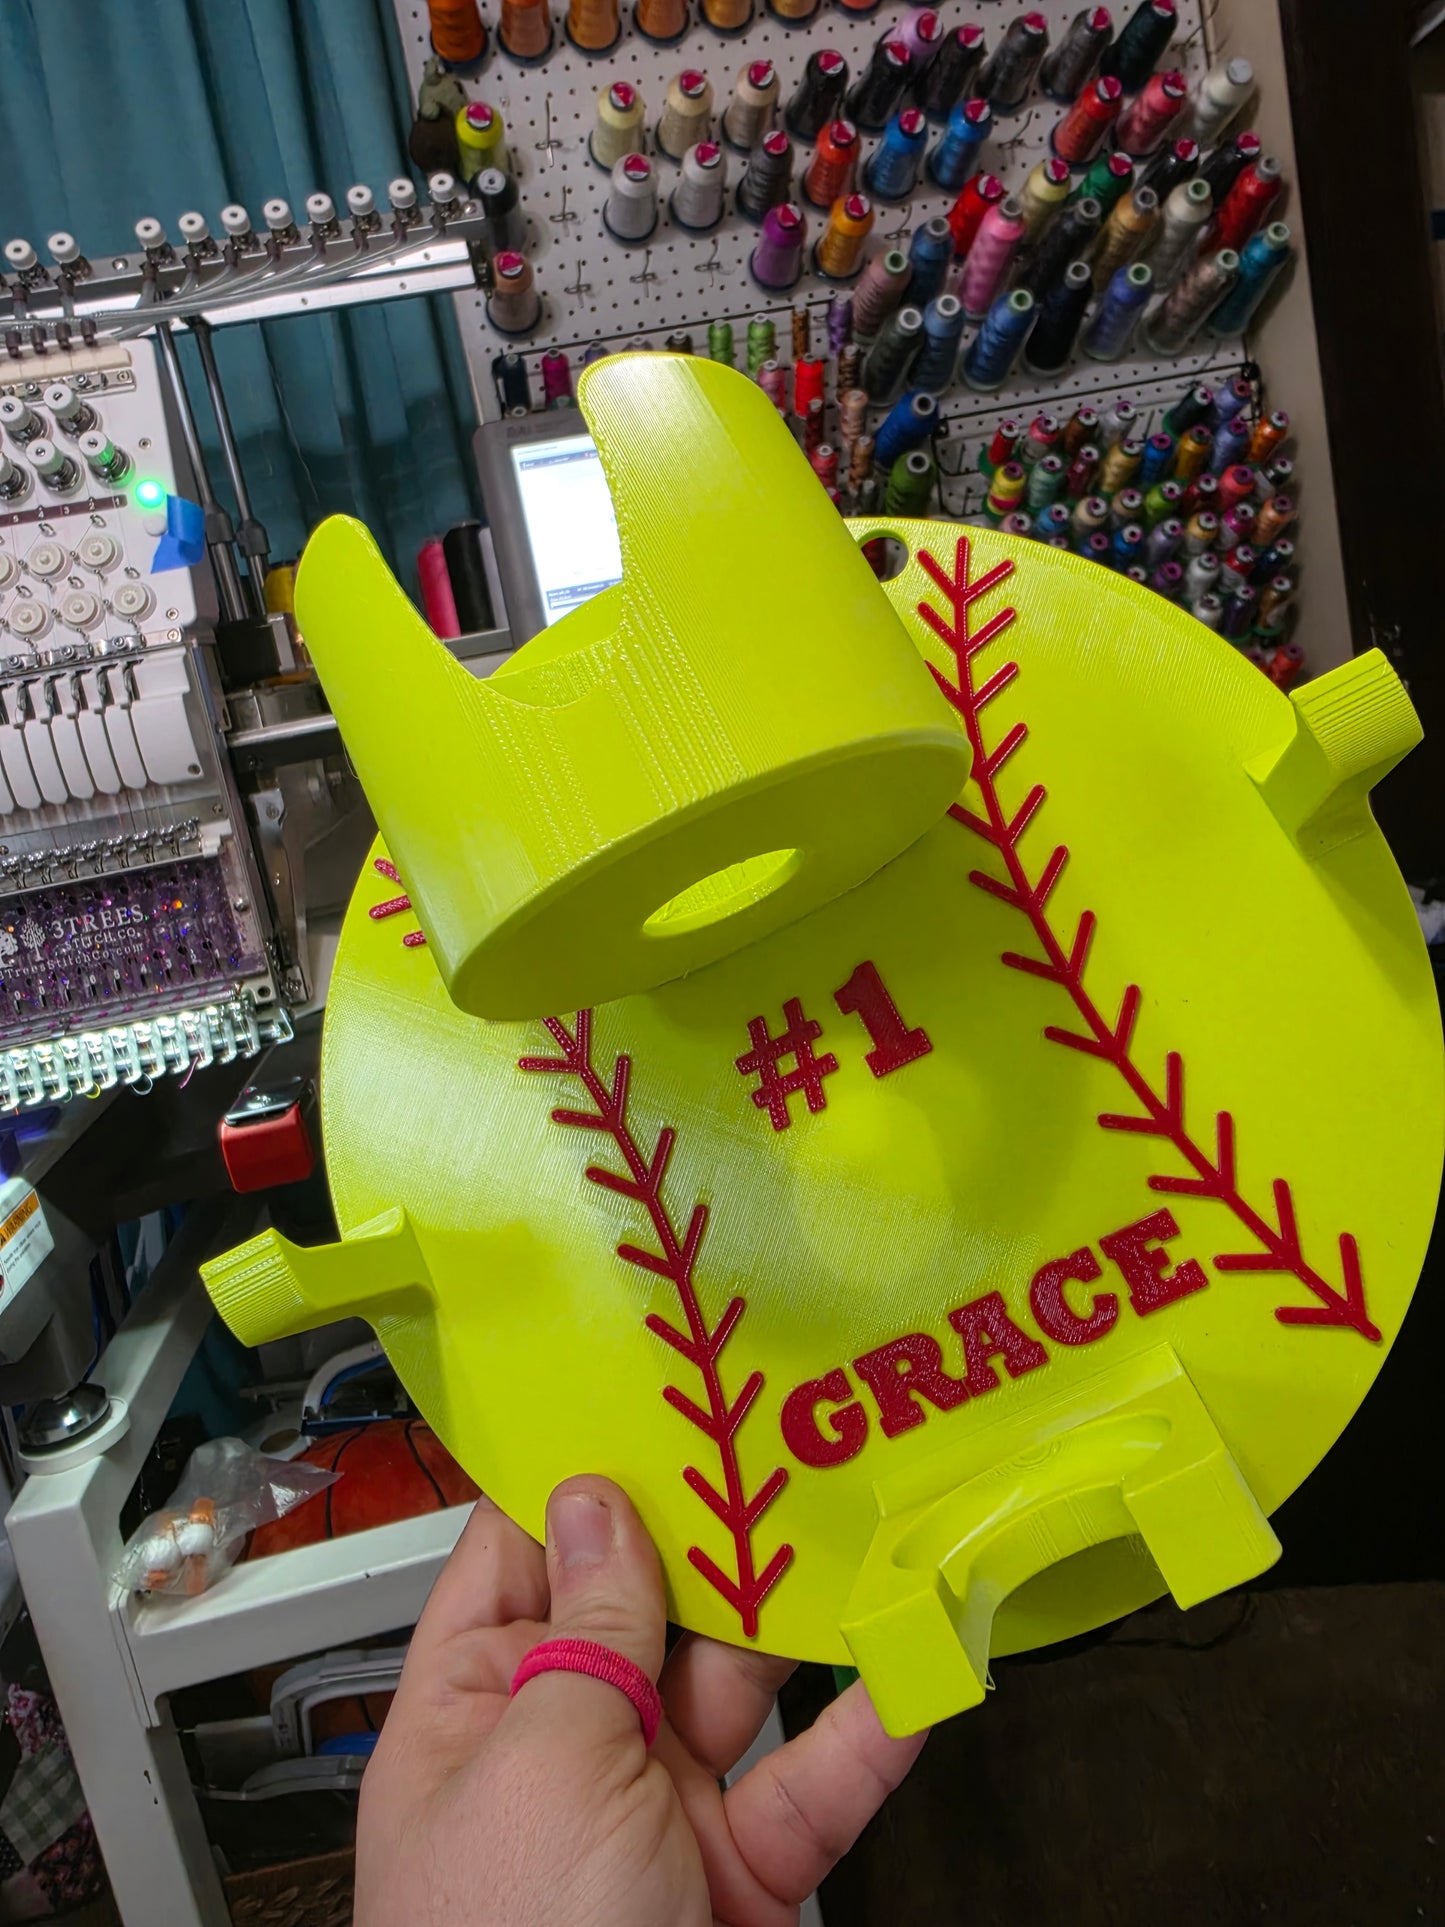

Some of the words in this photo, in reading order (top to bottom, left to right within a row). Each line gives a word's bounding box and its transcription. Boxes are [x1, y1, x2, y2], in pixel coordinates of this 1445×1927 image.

[38, 510, 45, 519] 4
[63, 506, 70, 515] 3
[88, 501, 96, 511] 2
[51, 904, 144, 939] 3TREES
[735, 960, 933, 1131] #1
[780, 1207, 1209, 1467] GRACE
